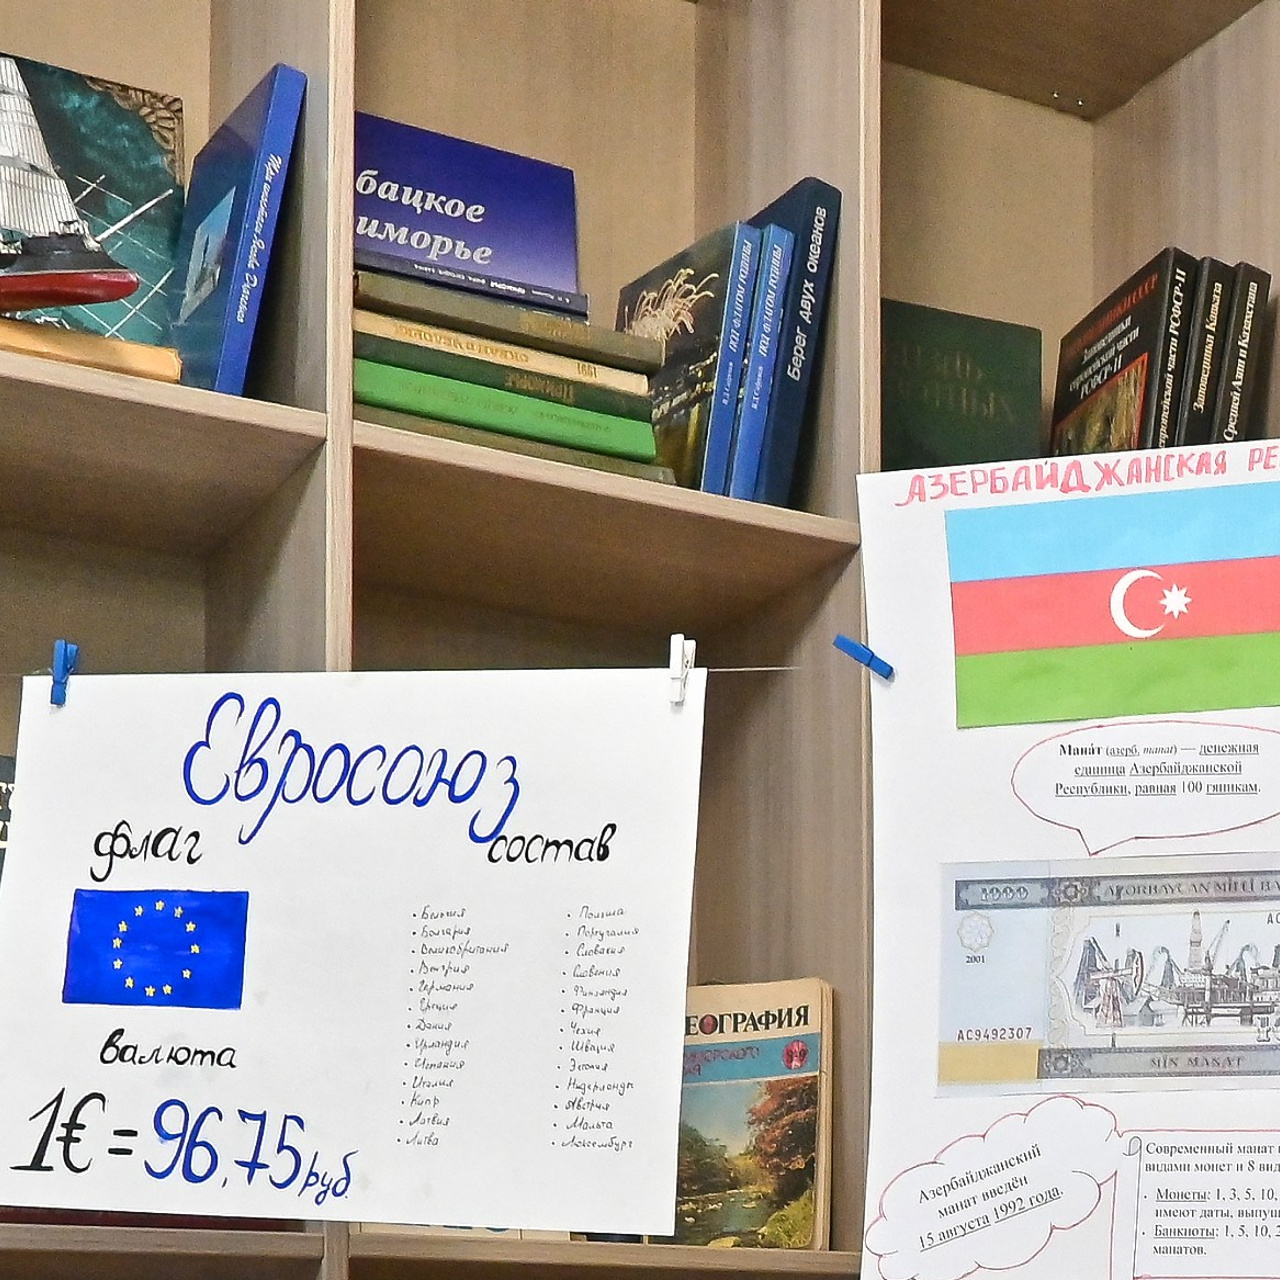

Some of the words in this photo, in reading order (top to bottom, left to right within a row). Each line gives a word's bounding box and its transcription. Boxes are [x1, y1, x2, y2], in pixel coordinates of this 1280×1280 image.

[355, 169, 486, 223] бацкое
[356, 215, 493, 265] иморье
[807, 207, 827, 273] океанов
[800, 280, 815, 324] двух
[787, 325, 808, 381] Берег
[1193, 333, 1215, 413] Заповедники
[1205, 283, 1223, 333] Кавказа
[1224, 391, 1241, 441] Средней
[895, 449, 1228, 507] АЗЕРБАЙДЖАНСКАЯ
[182, 691, 521, 846] Евросоюз
[1074, 764, 1125, 777] единица
[1129, 760, 1242, 775] Азербайджанской
[1199, 743, 1259, 755] денежная
[1055, 782, 1131, 797] Республики,
[1135, 783, 1176, 795] равная
[1182, 780, 1202, 793] 100
[1206, 782, 1261, 795] гяпикам.
[89, 820, 204, 883] флаг
[485, 822, 618, 864] состав
[965, 954, 986, 965] 2001
[98, 1027, 238, 1071] валюта
[957, 1027, 1032, 1042] AC9492307
[10, 1086, 107, 1174] 1€
[143, 1098, 306, 1190] 96,75
[1145, 1142, 1233, 1156] Современный
[1237, 1144, 1274, 1154] манат
[918, 1143, 1043, 1204] Азербайджанский
[1145, 1162, 1190, 1173] видами
[1195, 1162, 1232, 1172] монет
[1236, 1162, 1243, 1172] и
[1248, 1160, 1254, 1172] 8
[937, 1191, 979, 1219] манат
[981, 1173, 1029, 1204] введён
[1155, 1209, 1197, 1219] имеют
[1200, 1209, 1233, 1220] даты,
[1156, 1188, 1211, 1202] Монеты:
[919, 1231, 935, 1252] 15
[938, 1211, 991, 1244] августа
[993, 1196, 1026, 1226] 1992
[1028, 1186, 1064, 1217] года.
[1154, 1225, 1219, 1239] Банкноты:
[1153, 1245, 1207, 1256] манатов.
